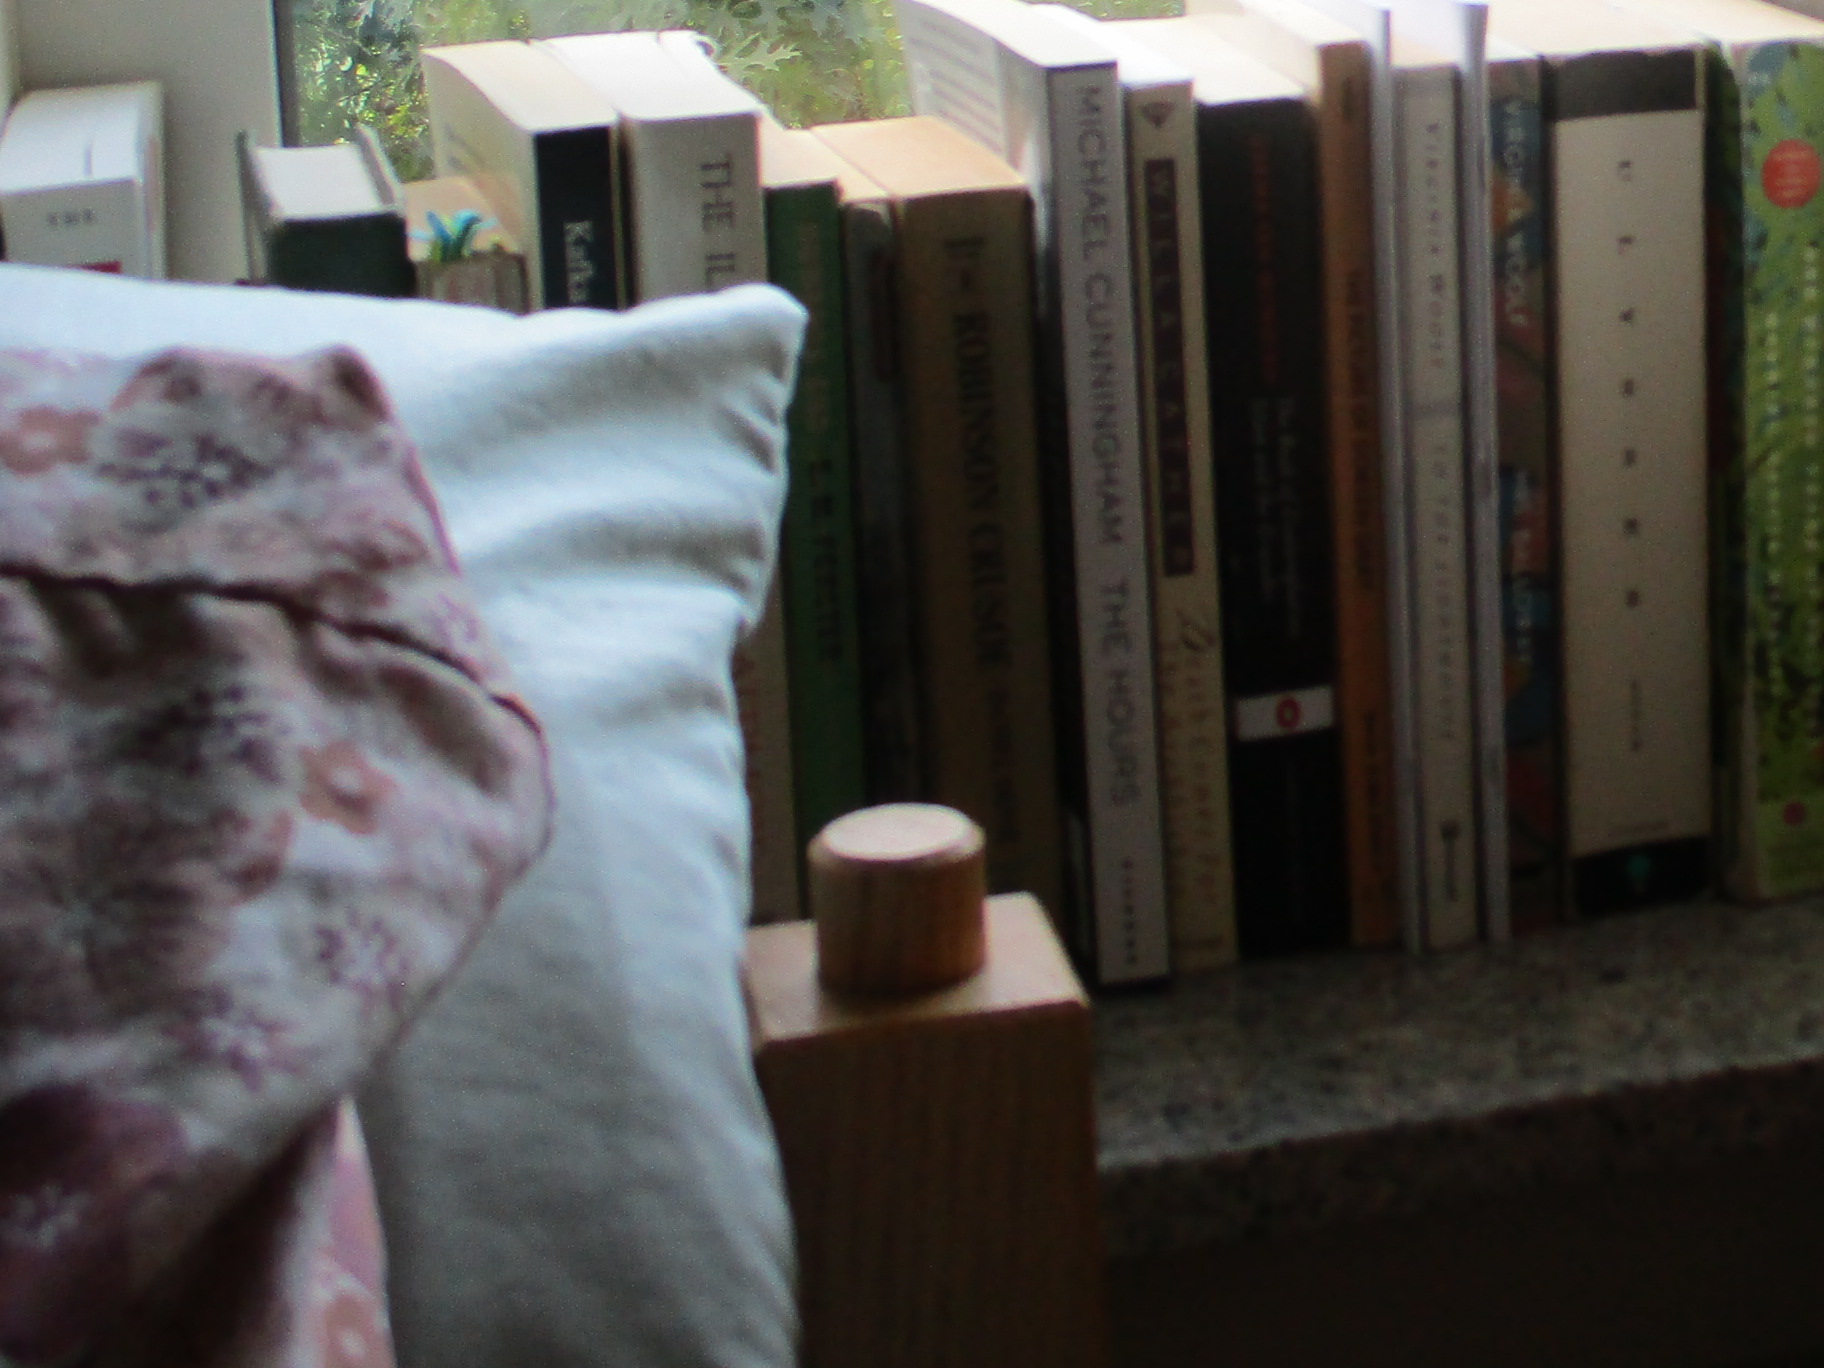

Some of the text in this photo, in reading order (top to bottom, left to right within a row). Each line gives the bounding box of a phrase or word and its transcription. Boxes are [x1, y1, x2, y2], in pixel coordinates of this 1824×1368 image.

[700, 151, 737, 233] THE
[1503, 100, 1526, 222] VIRGINIA
[563, 219, 596, 302] Kafka
[1427, 271, 1448, 371] WOOLF
[1505, 232, 1529, 329] WOOLF
[950, 312, 1002, 513] ROBINSON
[1147, 167, 1188, 568] WILLA CATHER
[1076, 86, 1142, 807] MICHAEL CUNNINGHAM THE HOURS
[967, 523, 1014, 674] CRUSOE
